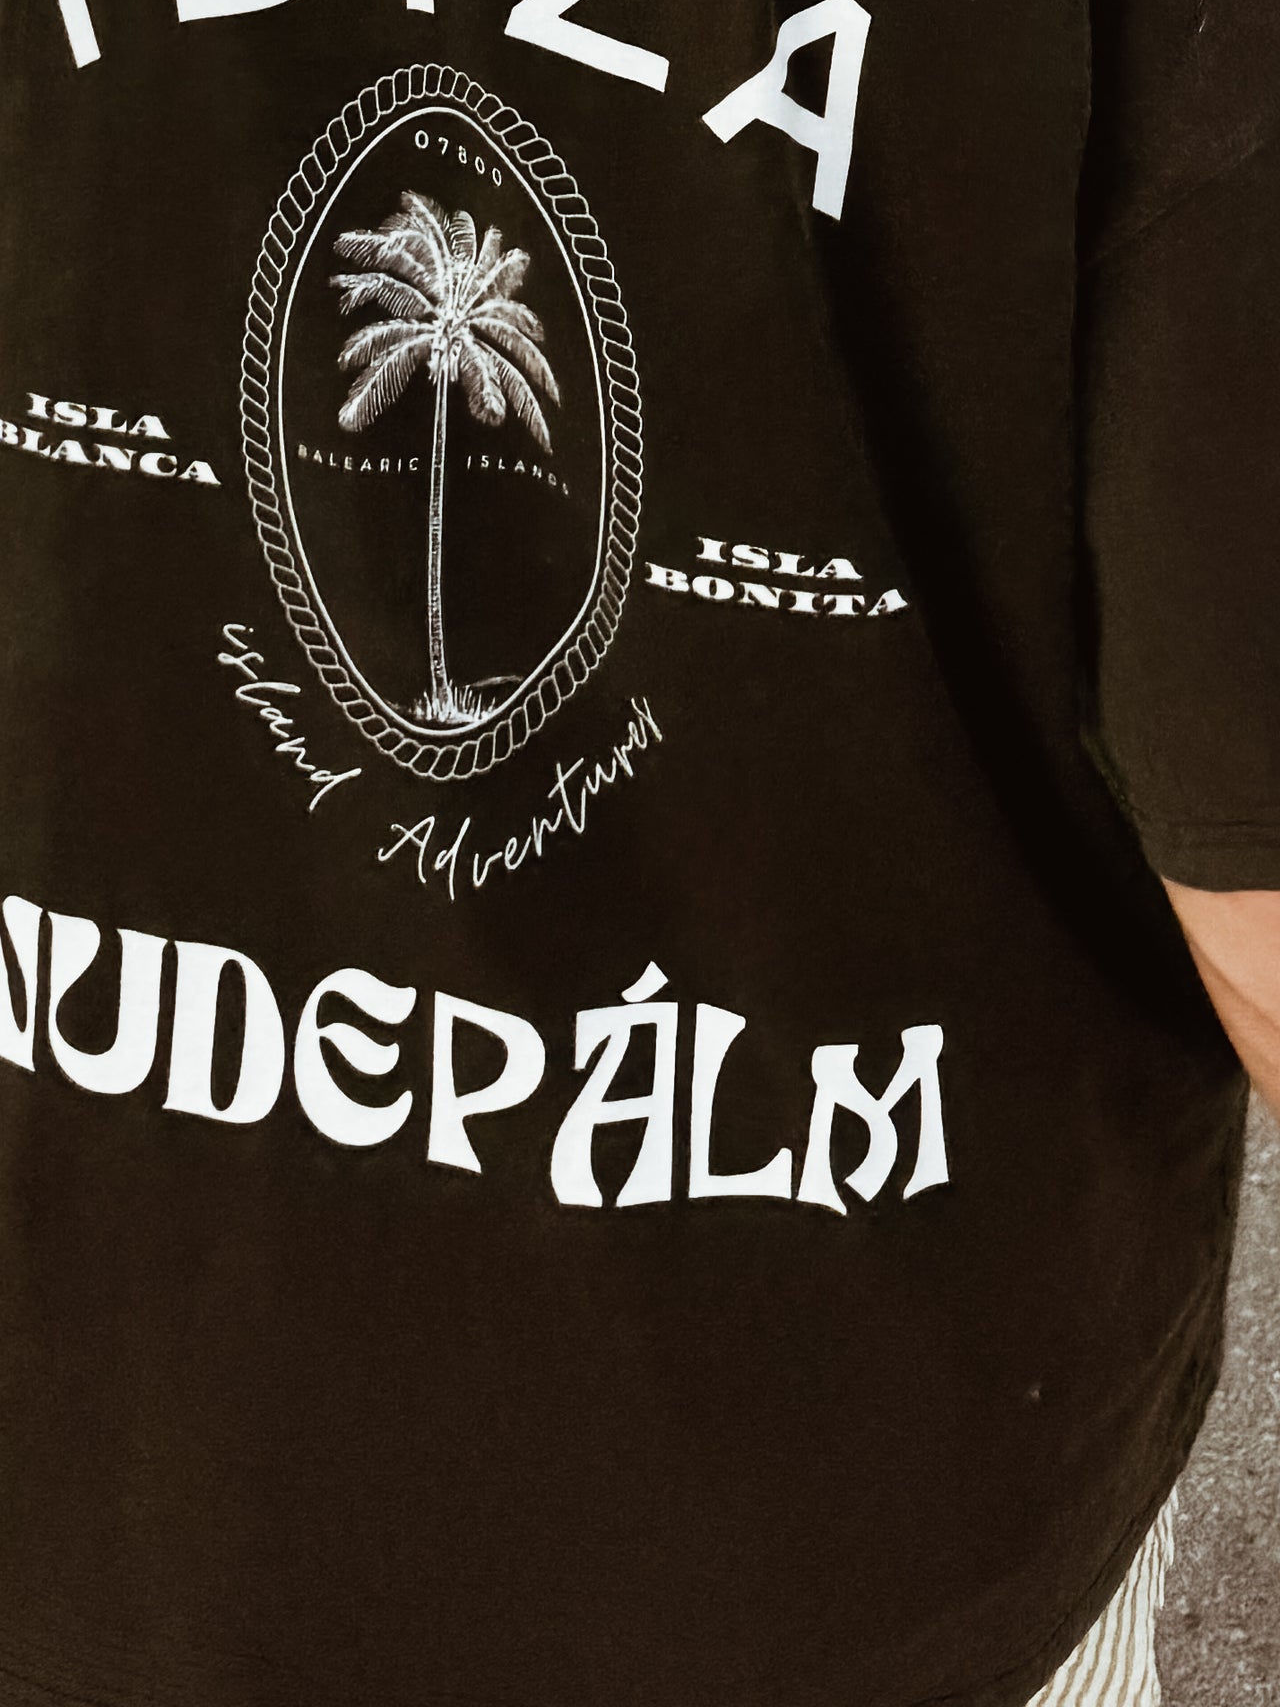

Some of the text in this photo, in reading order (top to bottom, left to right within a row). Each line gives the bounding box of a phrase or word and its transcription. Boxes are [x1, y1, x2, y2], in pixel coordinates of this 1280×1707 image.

[414, 129, 504, 188] 07800
[26, 391, 173, 440] ISLA
[297, 443, 571, 497] BALEARIC ISLANDS
[695, 536, 864, 580] ISLA
[644, 561, 909, 616] BONITA
[218, 622, 664, 902] island Adventures
